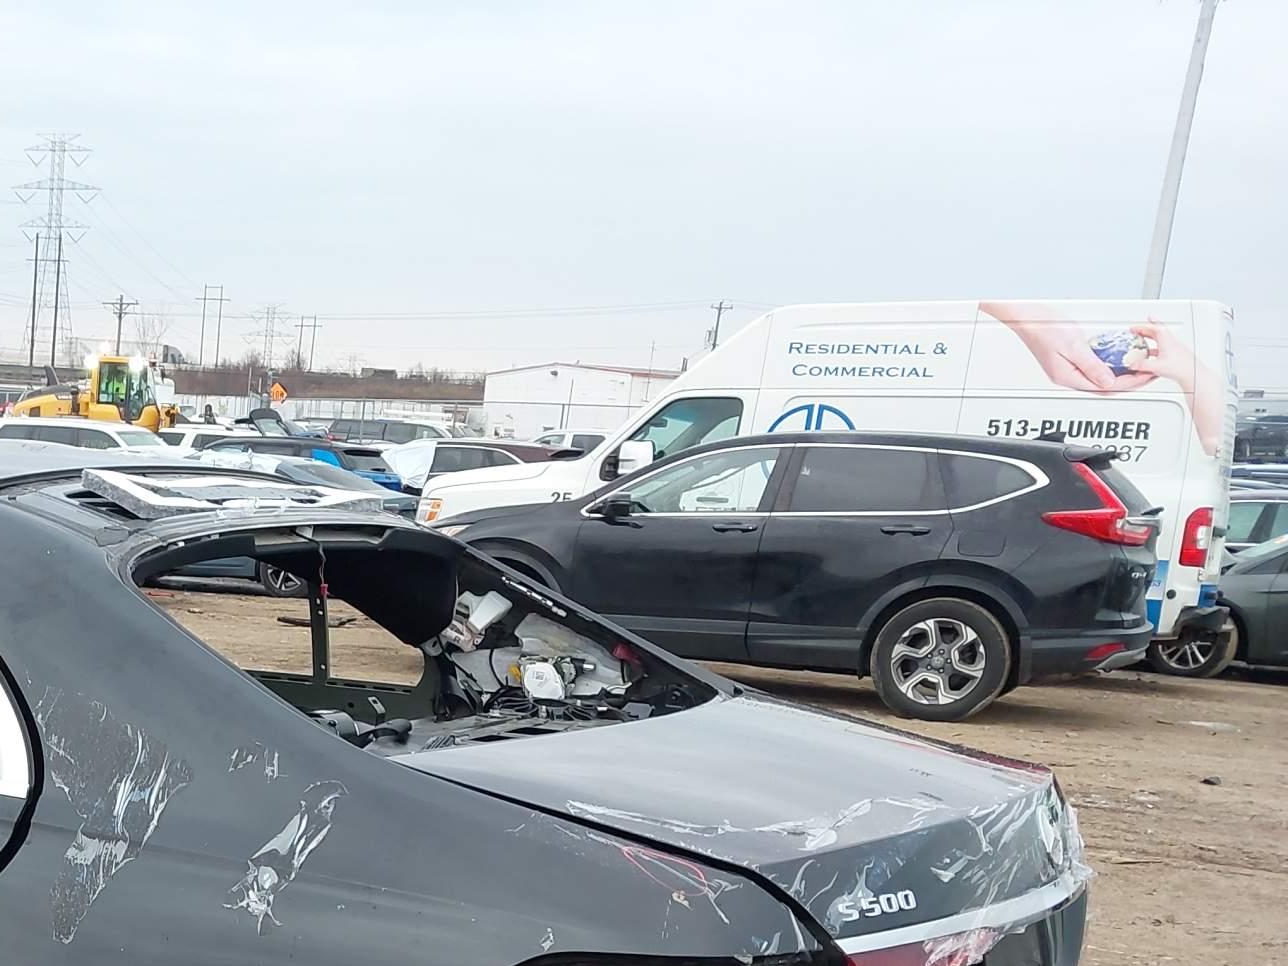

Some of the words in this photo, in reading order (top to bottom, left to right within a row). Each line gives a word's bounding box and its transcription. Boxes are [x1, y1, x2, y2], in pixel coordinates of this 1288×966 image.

[788, 342, 926, 355] RESIDENTIAL
[933, 342, 948, 355] &
[792, 364, 934, 378] COMMERCIAL
[987, 419, 1151, 440] 513-PLUMBER
[838, 901, 860, 922] S
[861, 889, 917, 918] 500
